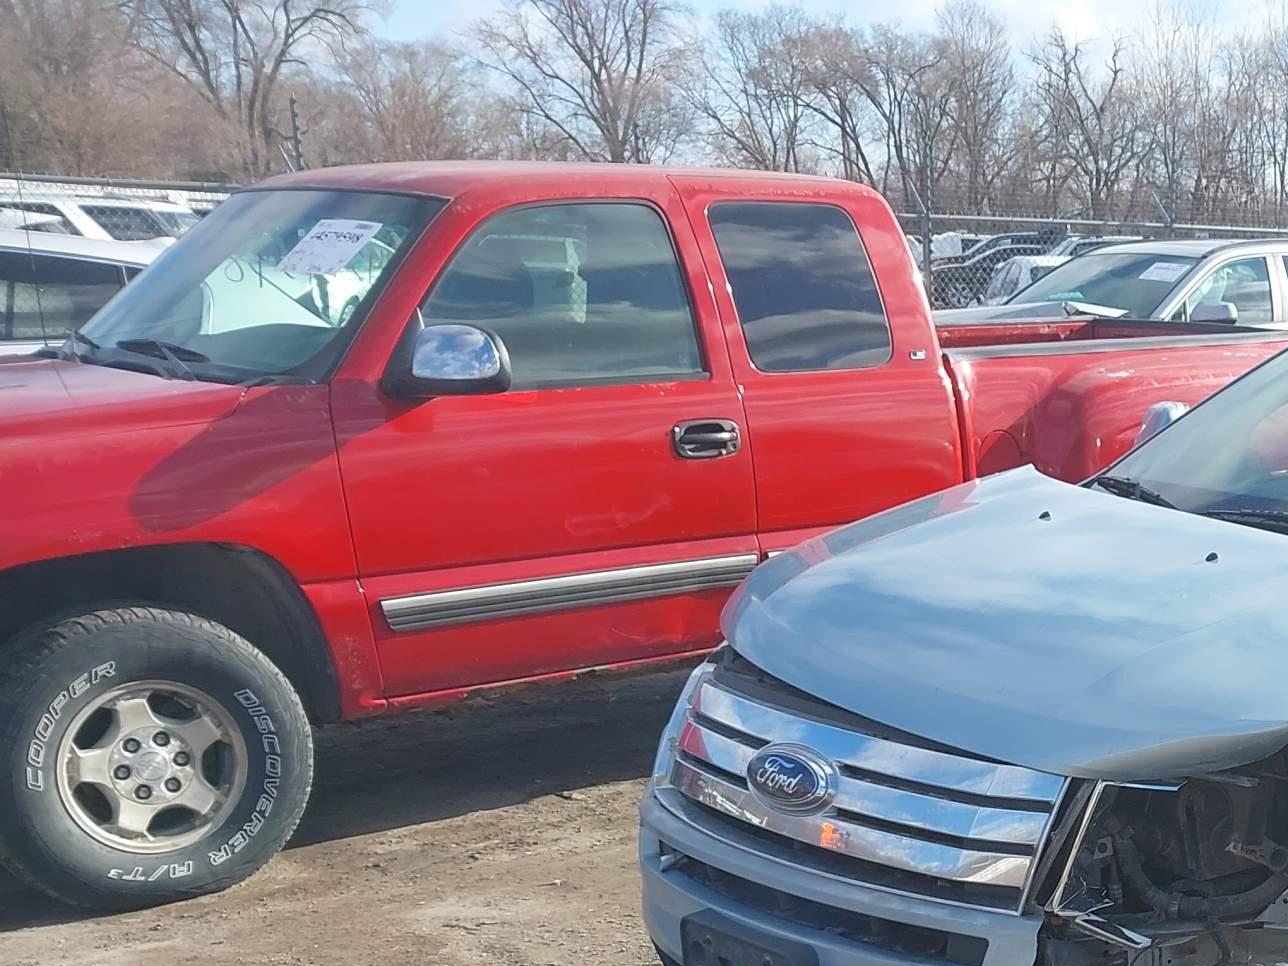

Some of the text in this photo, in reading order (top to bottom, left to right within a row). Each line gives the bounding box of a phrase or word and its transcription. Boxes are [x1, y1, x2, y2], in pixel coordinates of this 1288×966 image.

[26, 660, 116, 792] COOPER
[207, 688, 282, 866] DISCOVERER
[756, 756, 803, 794] Ford
